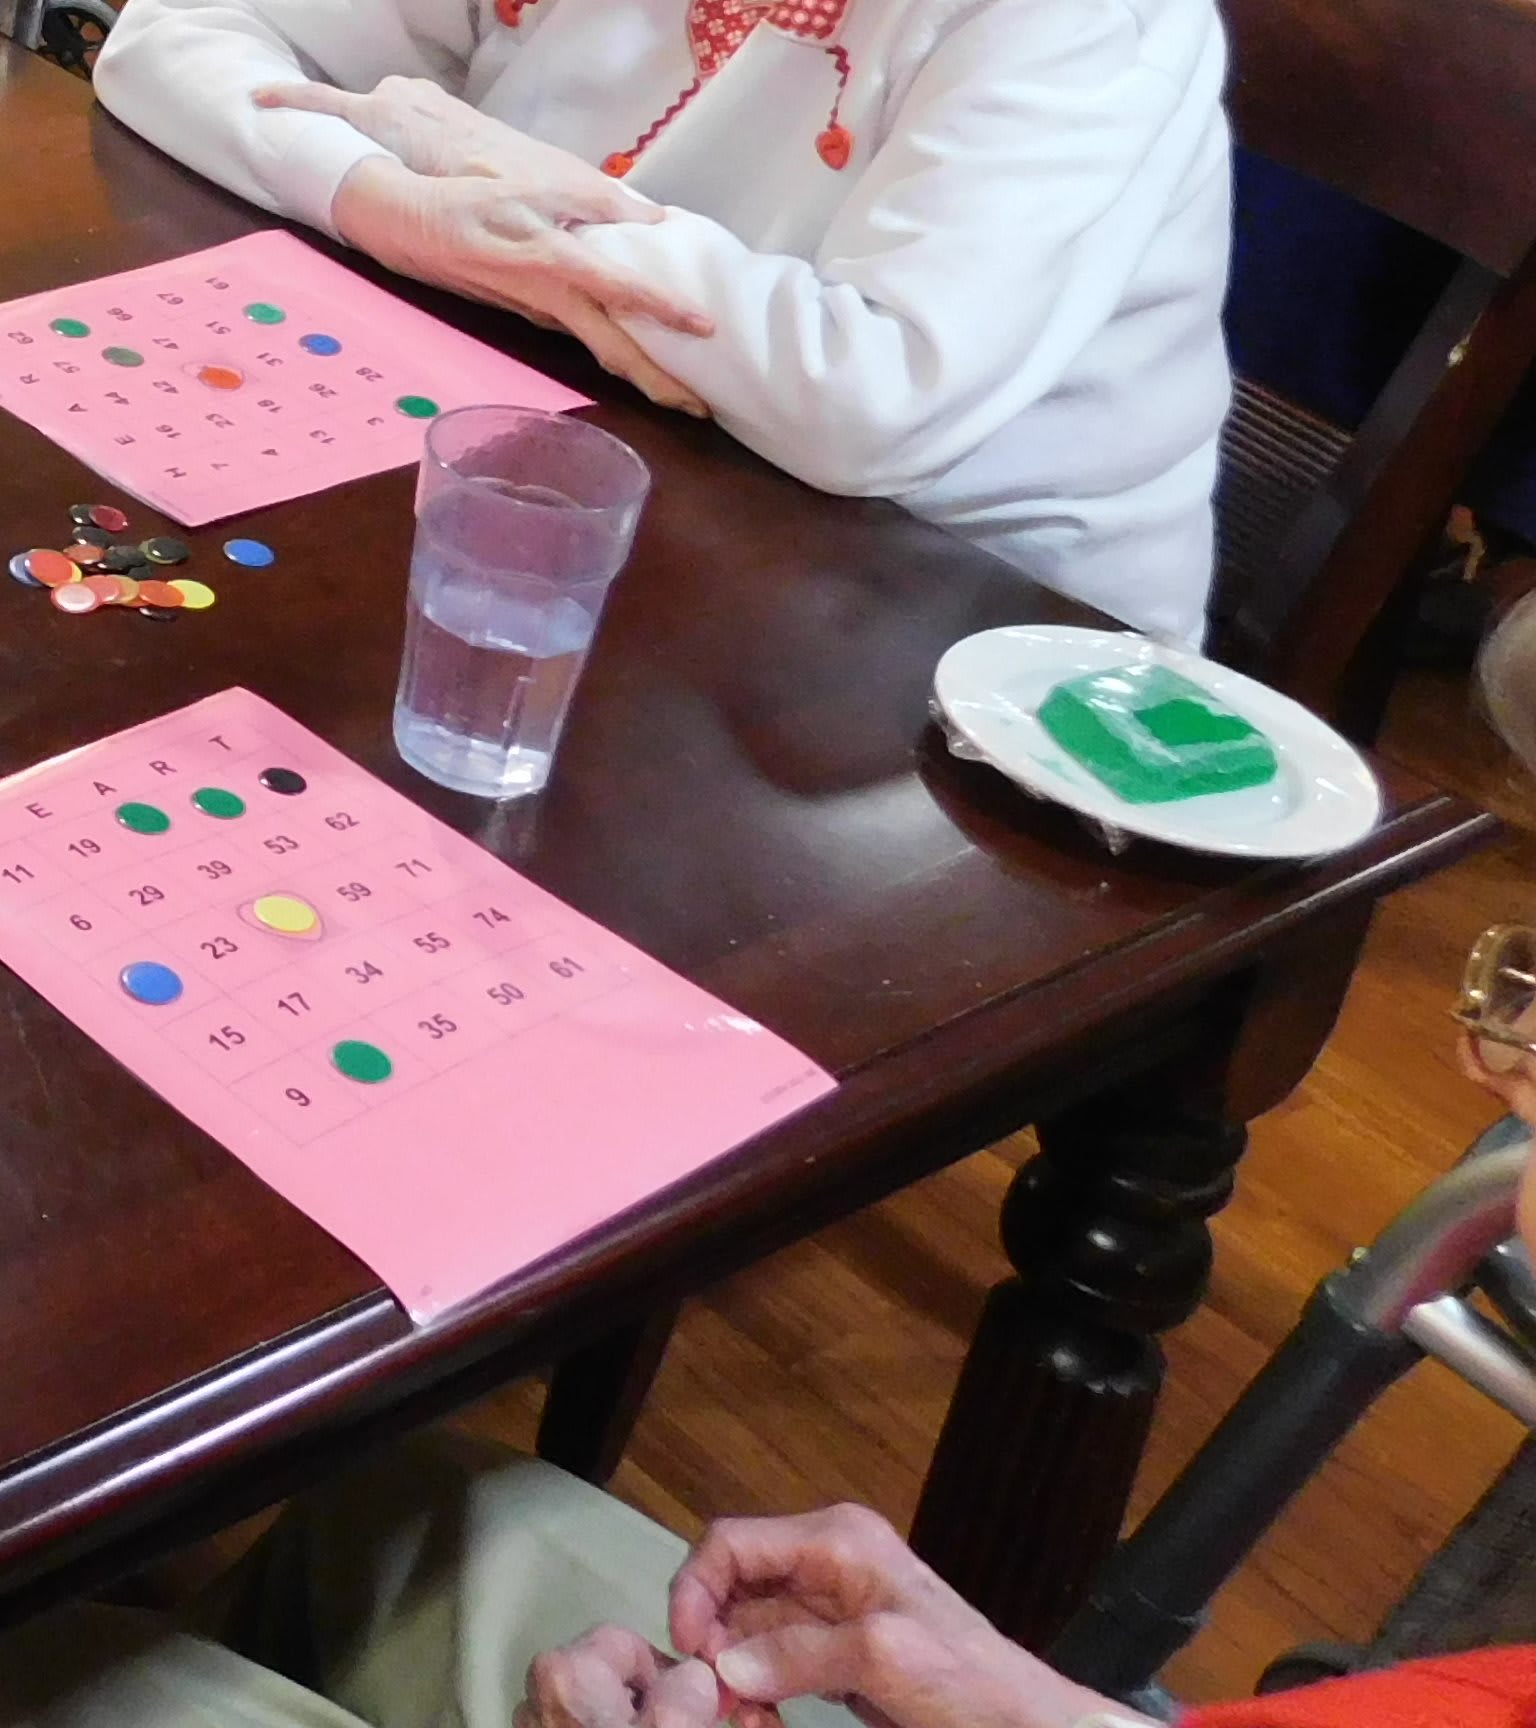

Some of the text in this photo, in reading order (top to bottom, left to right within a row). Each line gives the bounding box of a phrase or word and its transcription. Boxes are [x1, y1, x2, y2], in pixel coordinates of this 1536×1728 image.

[25, 802, 54, 819] E
[92, 781, 117, 796] A
[148, 760, 177, 776] R
[207, 735, 232, 751] T
[2, 838, 102, 884] 11 19
[69, 812, 361, 931] 6 29 39 53 62
[200, 858, 433, 960] 23 59 71
[209, 907, 511, 1051] 15 17 34 55 74
[285, 956, 585, 1107] 9 35 50 61
